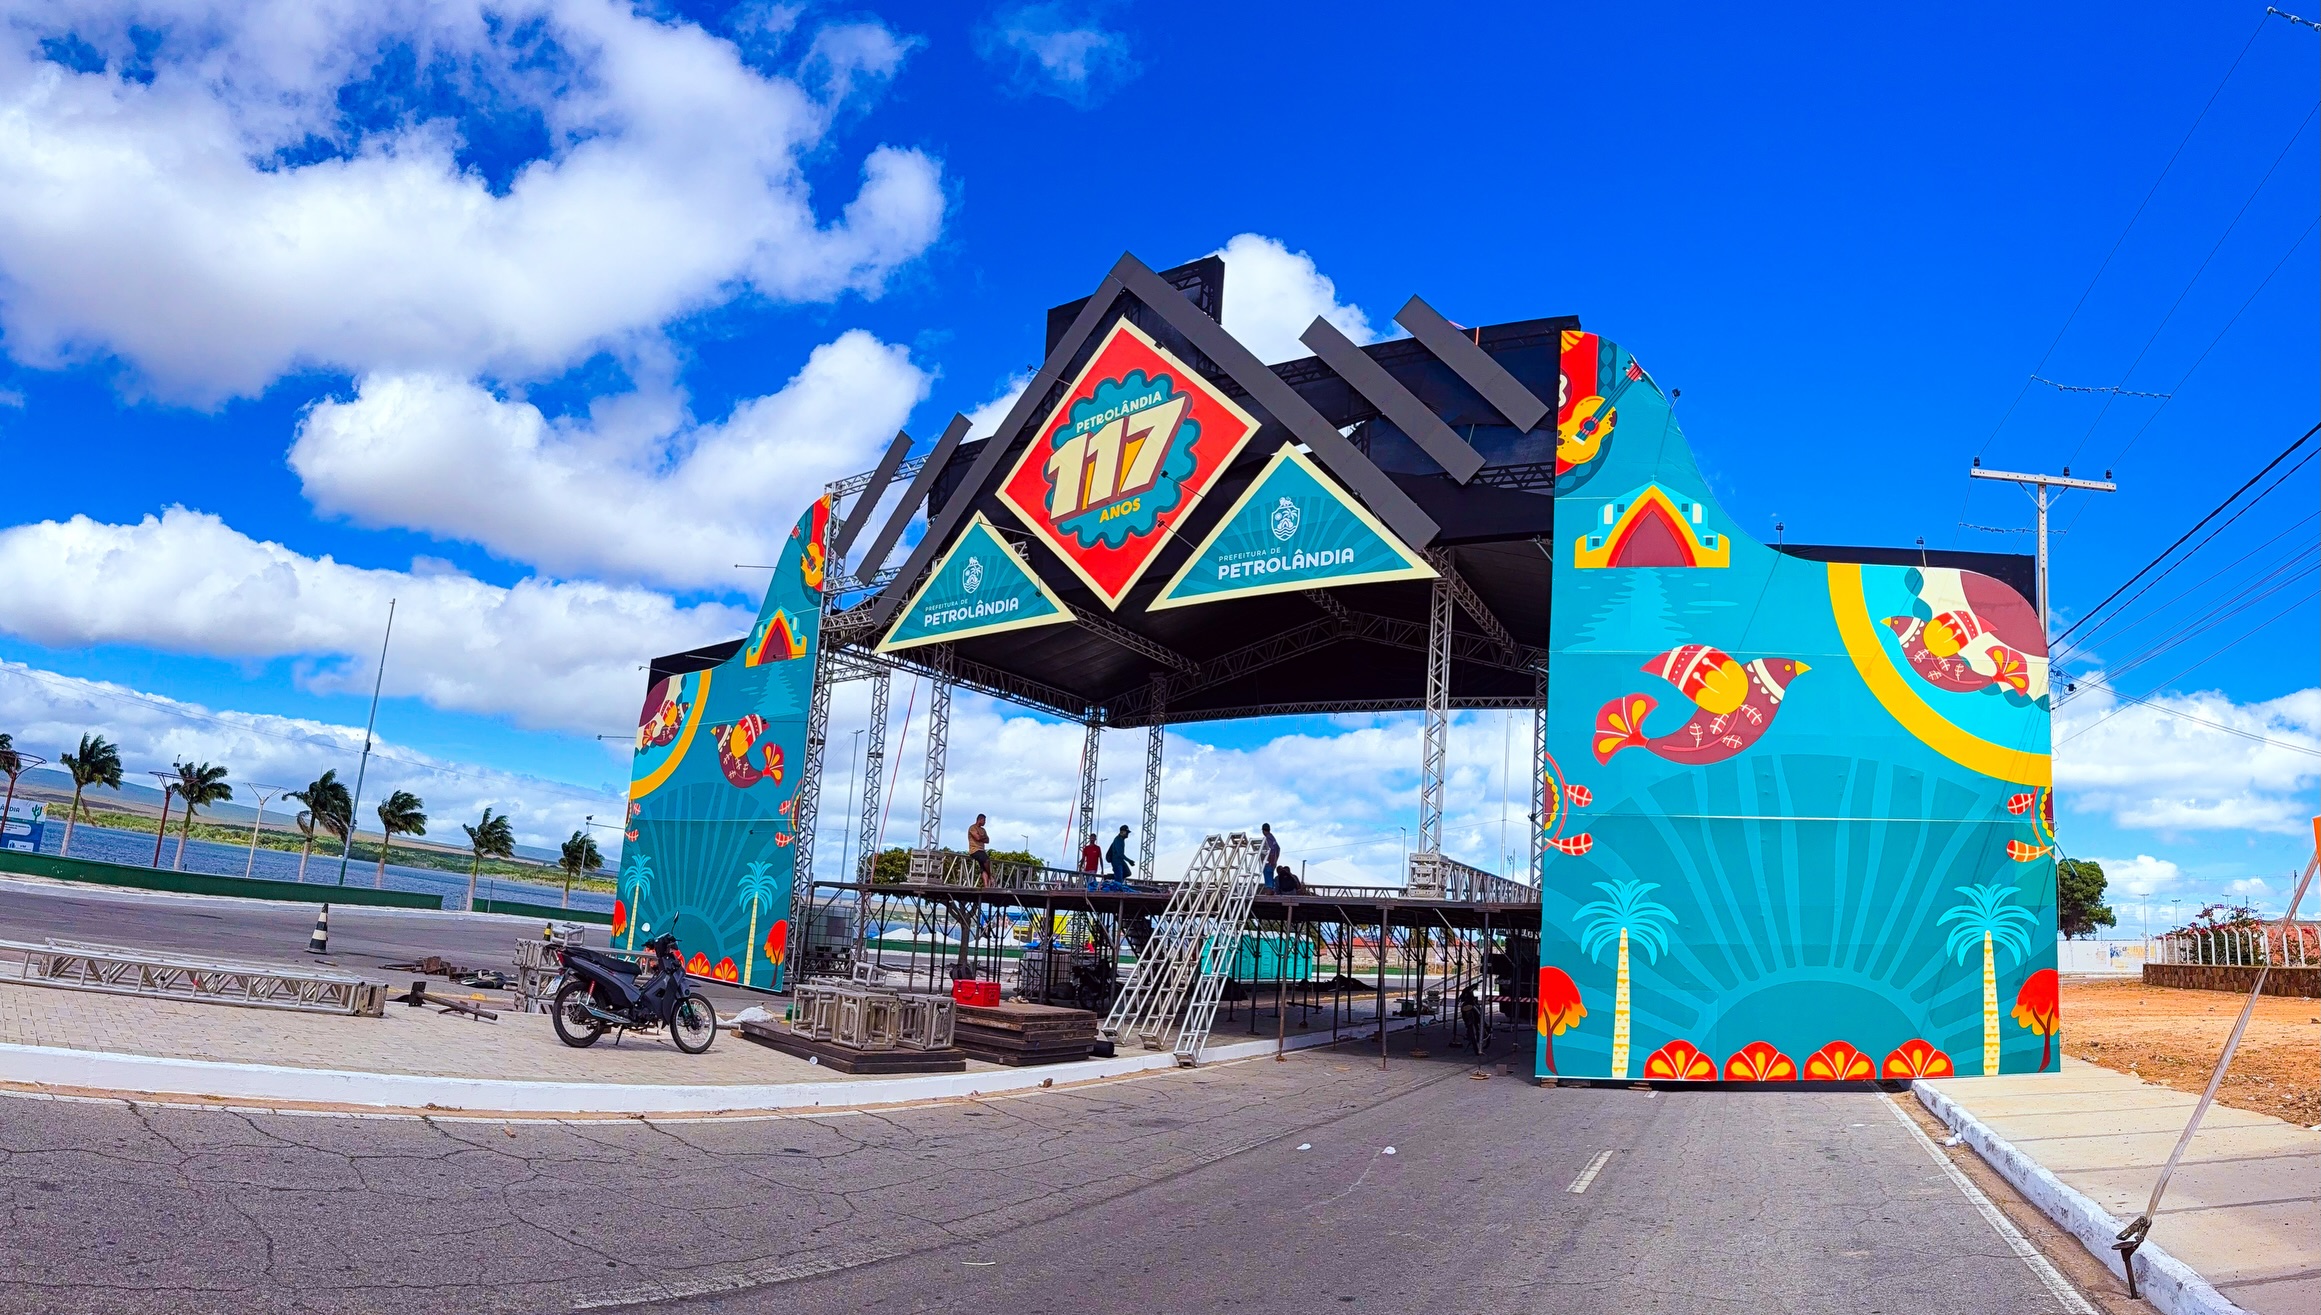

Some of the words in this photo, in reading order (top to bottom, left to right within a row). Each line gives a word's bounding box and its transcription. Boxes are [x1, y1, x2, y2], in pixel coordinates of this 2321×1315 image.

[1076, 391, 1162, 434] PETROLÂNDIA
[1047, 396, 1188, 521] 117
[1099, 498, 1141, 523] ANOS
[1217, 547, 1355, 581] PETROLÂNDIA
[1218, 549, 1267, 562] PREFEITURA
[1270, 547, 1281, 555] DE
[924, 597, 1019, 628] PETROLÂNDIA
[925, 600, 959, 612] PREFEITURA
